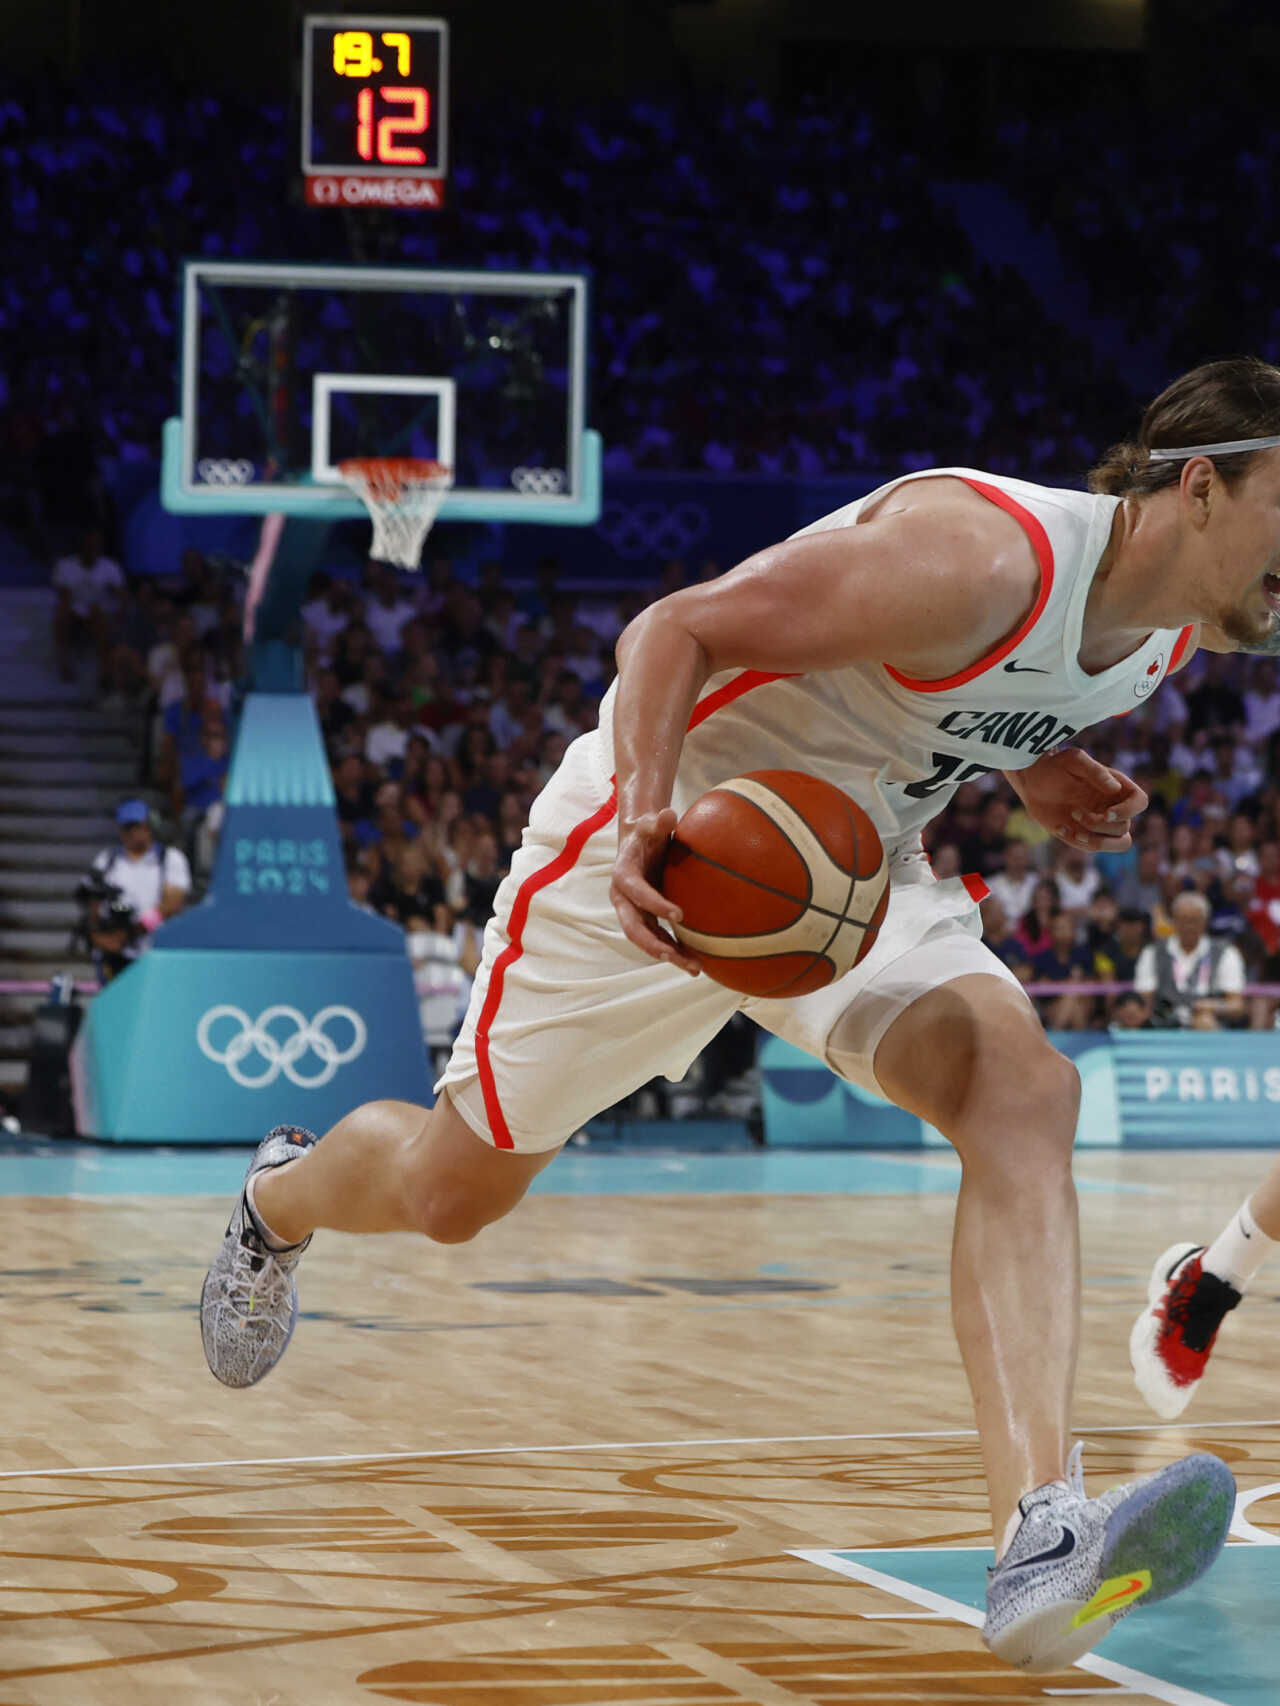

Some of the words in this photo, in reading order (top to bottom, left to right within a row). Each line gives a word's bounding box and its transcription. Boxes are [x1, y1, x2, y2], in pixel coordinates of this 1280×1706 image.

[357, 86, 429, 165] 12
[341, 178, 439, 206] OMEGA
[234, 839, 328, 865] PARIS
